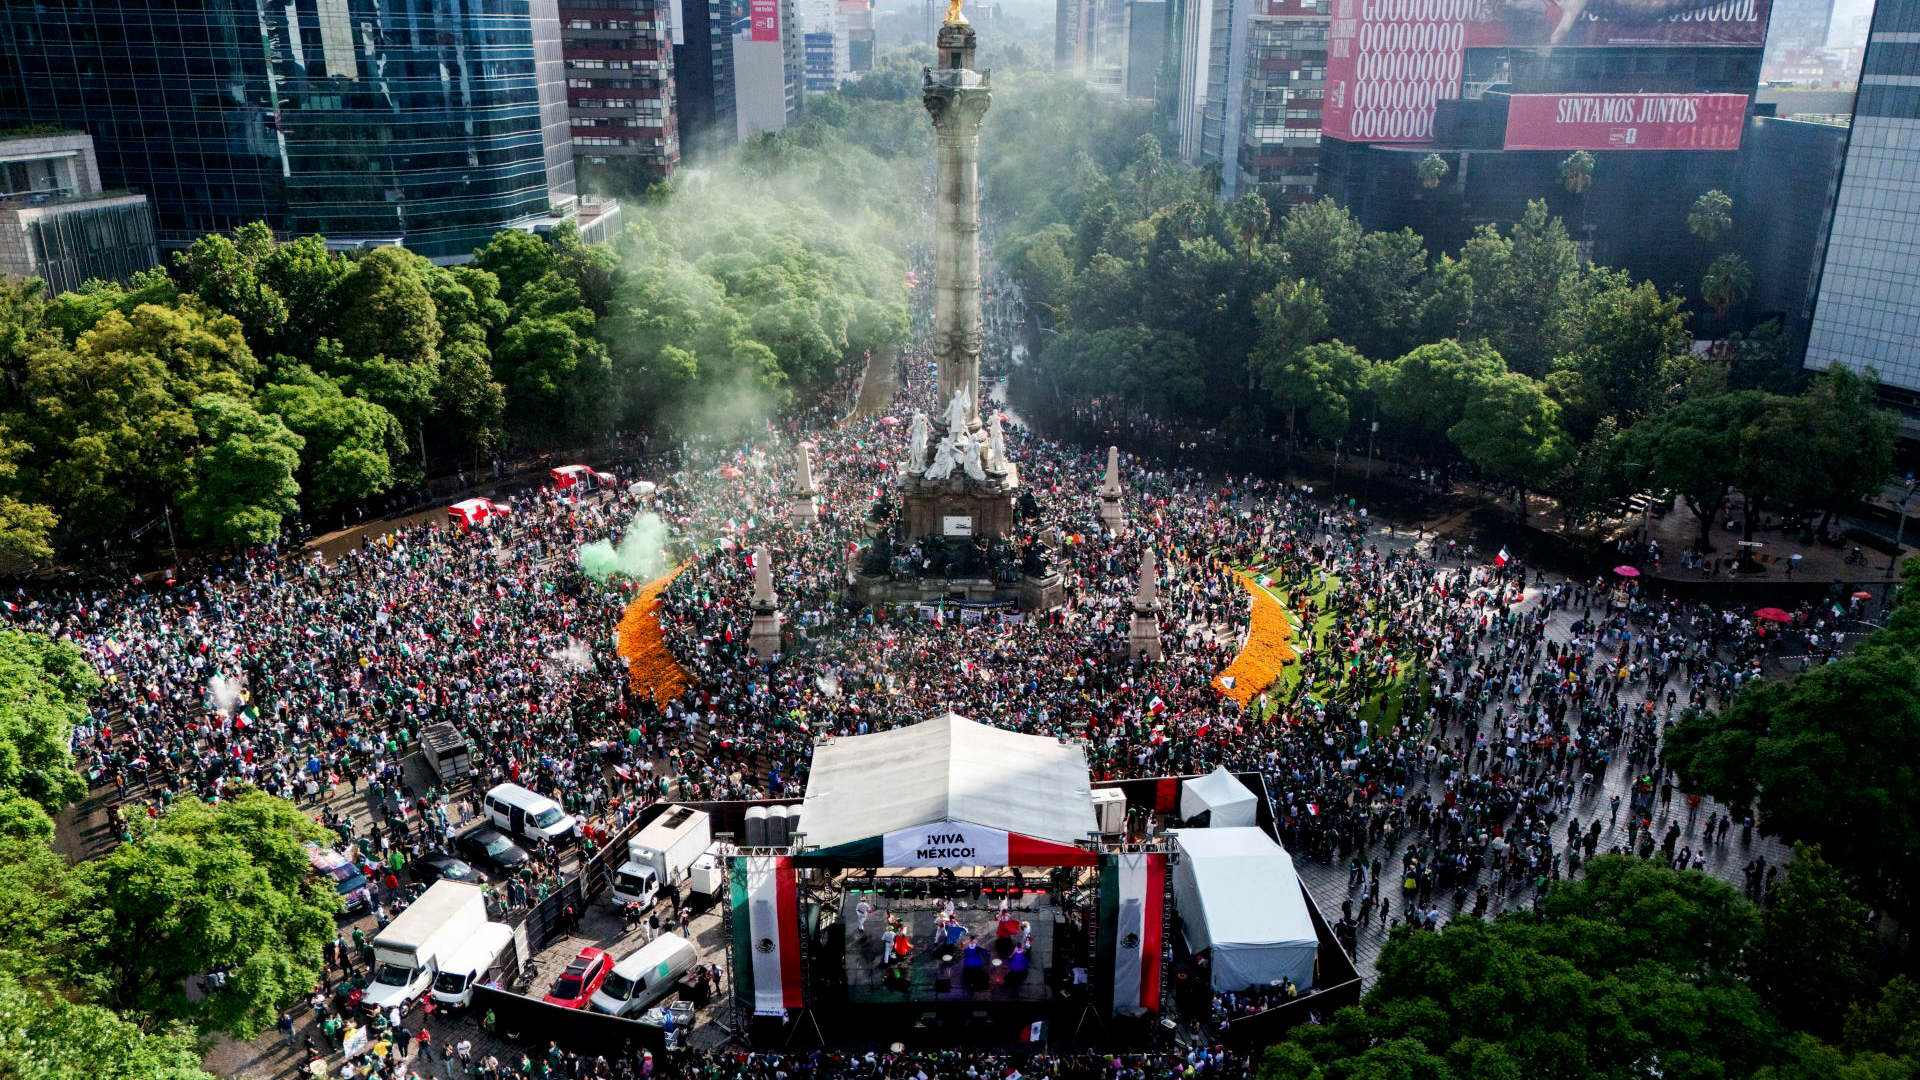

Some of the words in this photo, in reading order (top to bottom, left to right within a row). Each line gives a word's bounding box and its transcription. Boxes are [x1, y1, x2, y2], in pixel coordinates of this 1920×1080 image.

[1556, 98, 1635, 123] SINTAMOS
[1637, 98, 1699, 123] JUNTOS
[927, 834, 965, 845] ¡VIVA
[917, 847, 976, 859] MÉXICO!
